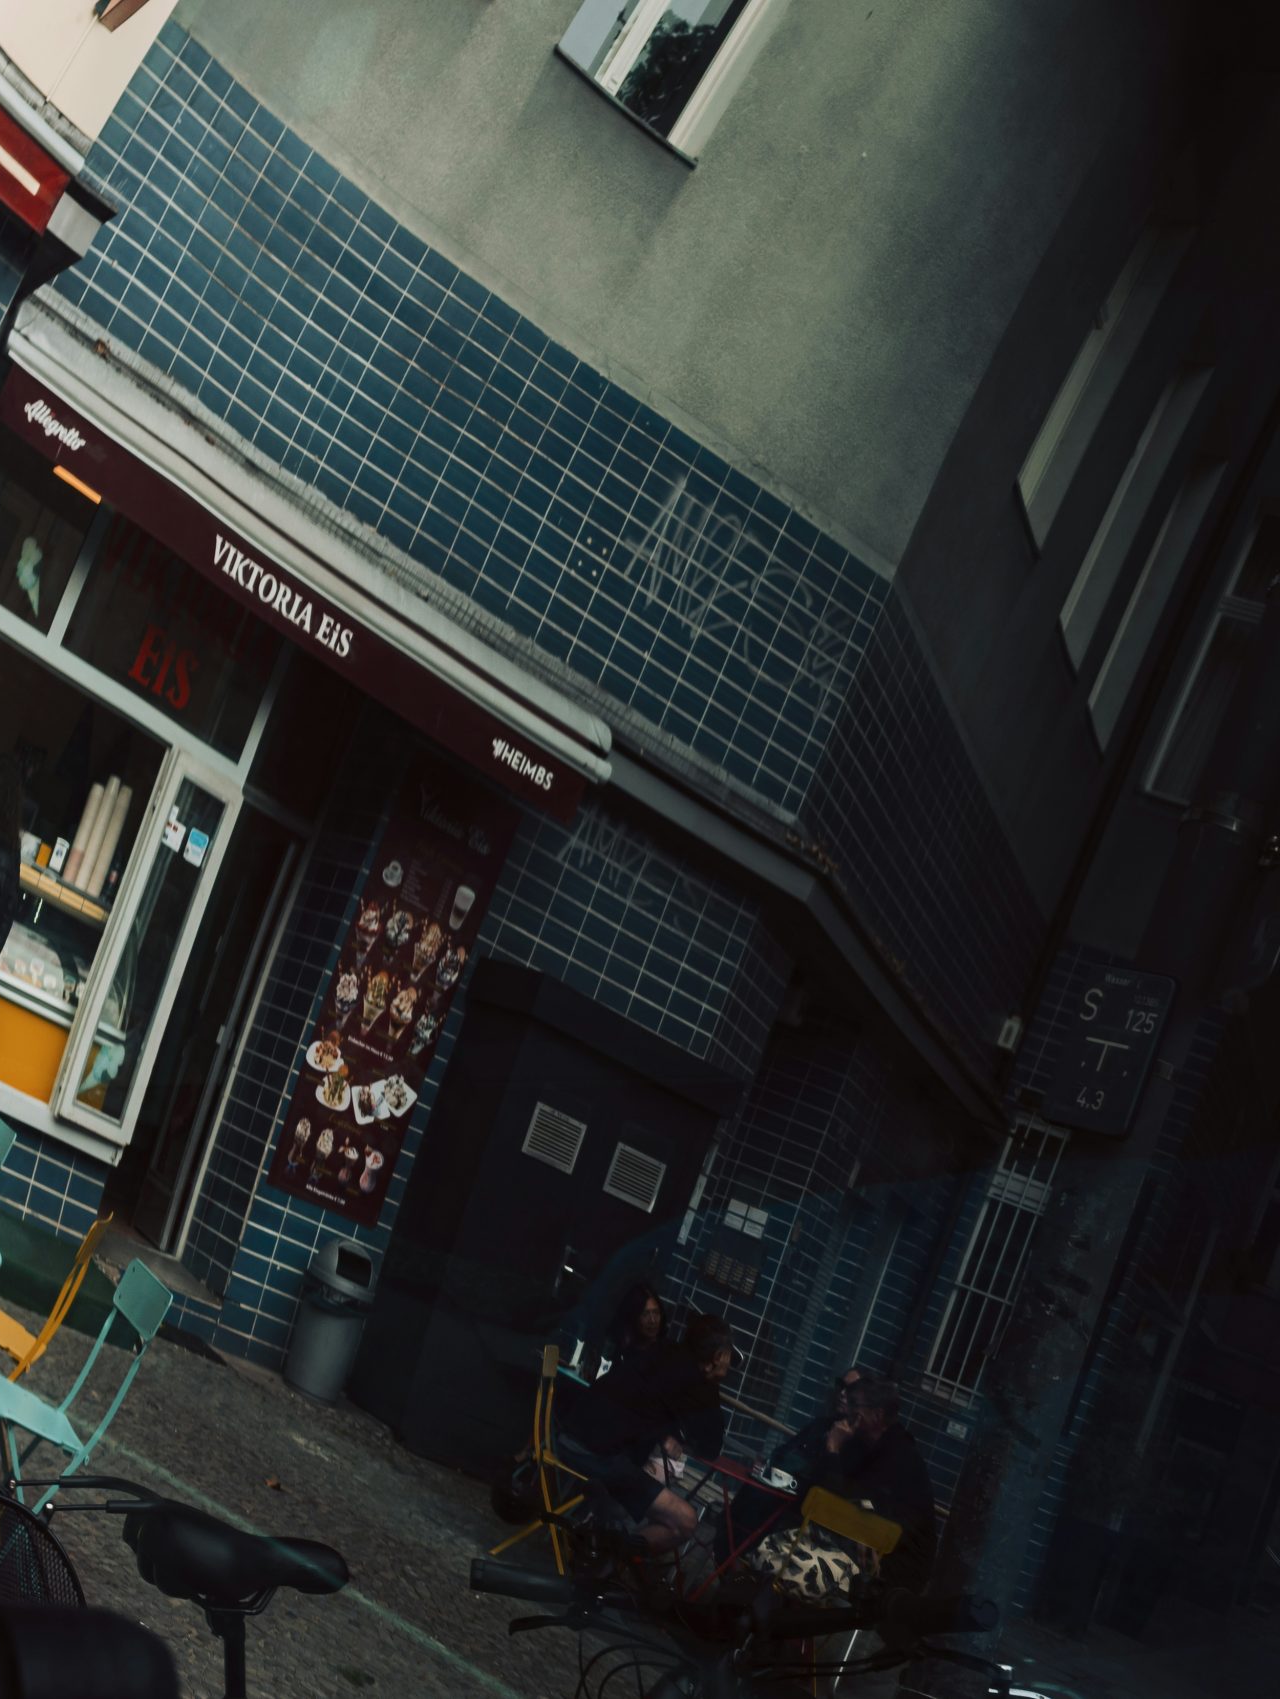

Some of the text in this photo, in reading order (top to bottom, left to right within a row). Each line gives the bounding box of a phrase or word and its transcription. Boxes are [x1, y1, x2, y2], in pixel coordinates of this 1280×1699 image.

[213, 533, 314, 634] VIKTORIA
[500, 742, 555, 791] HEIMBS
[1080, 988, 1104, 1021] S
[1124, 1008, 1159, 1035] 125
